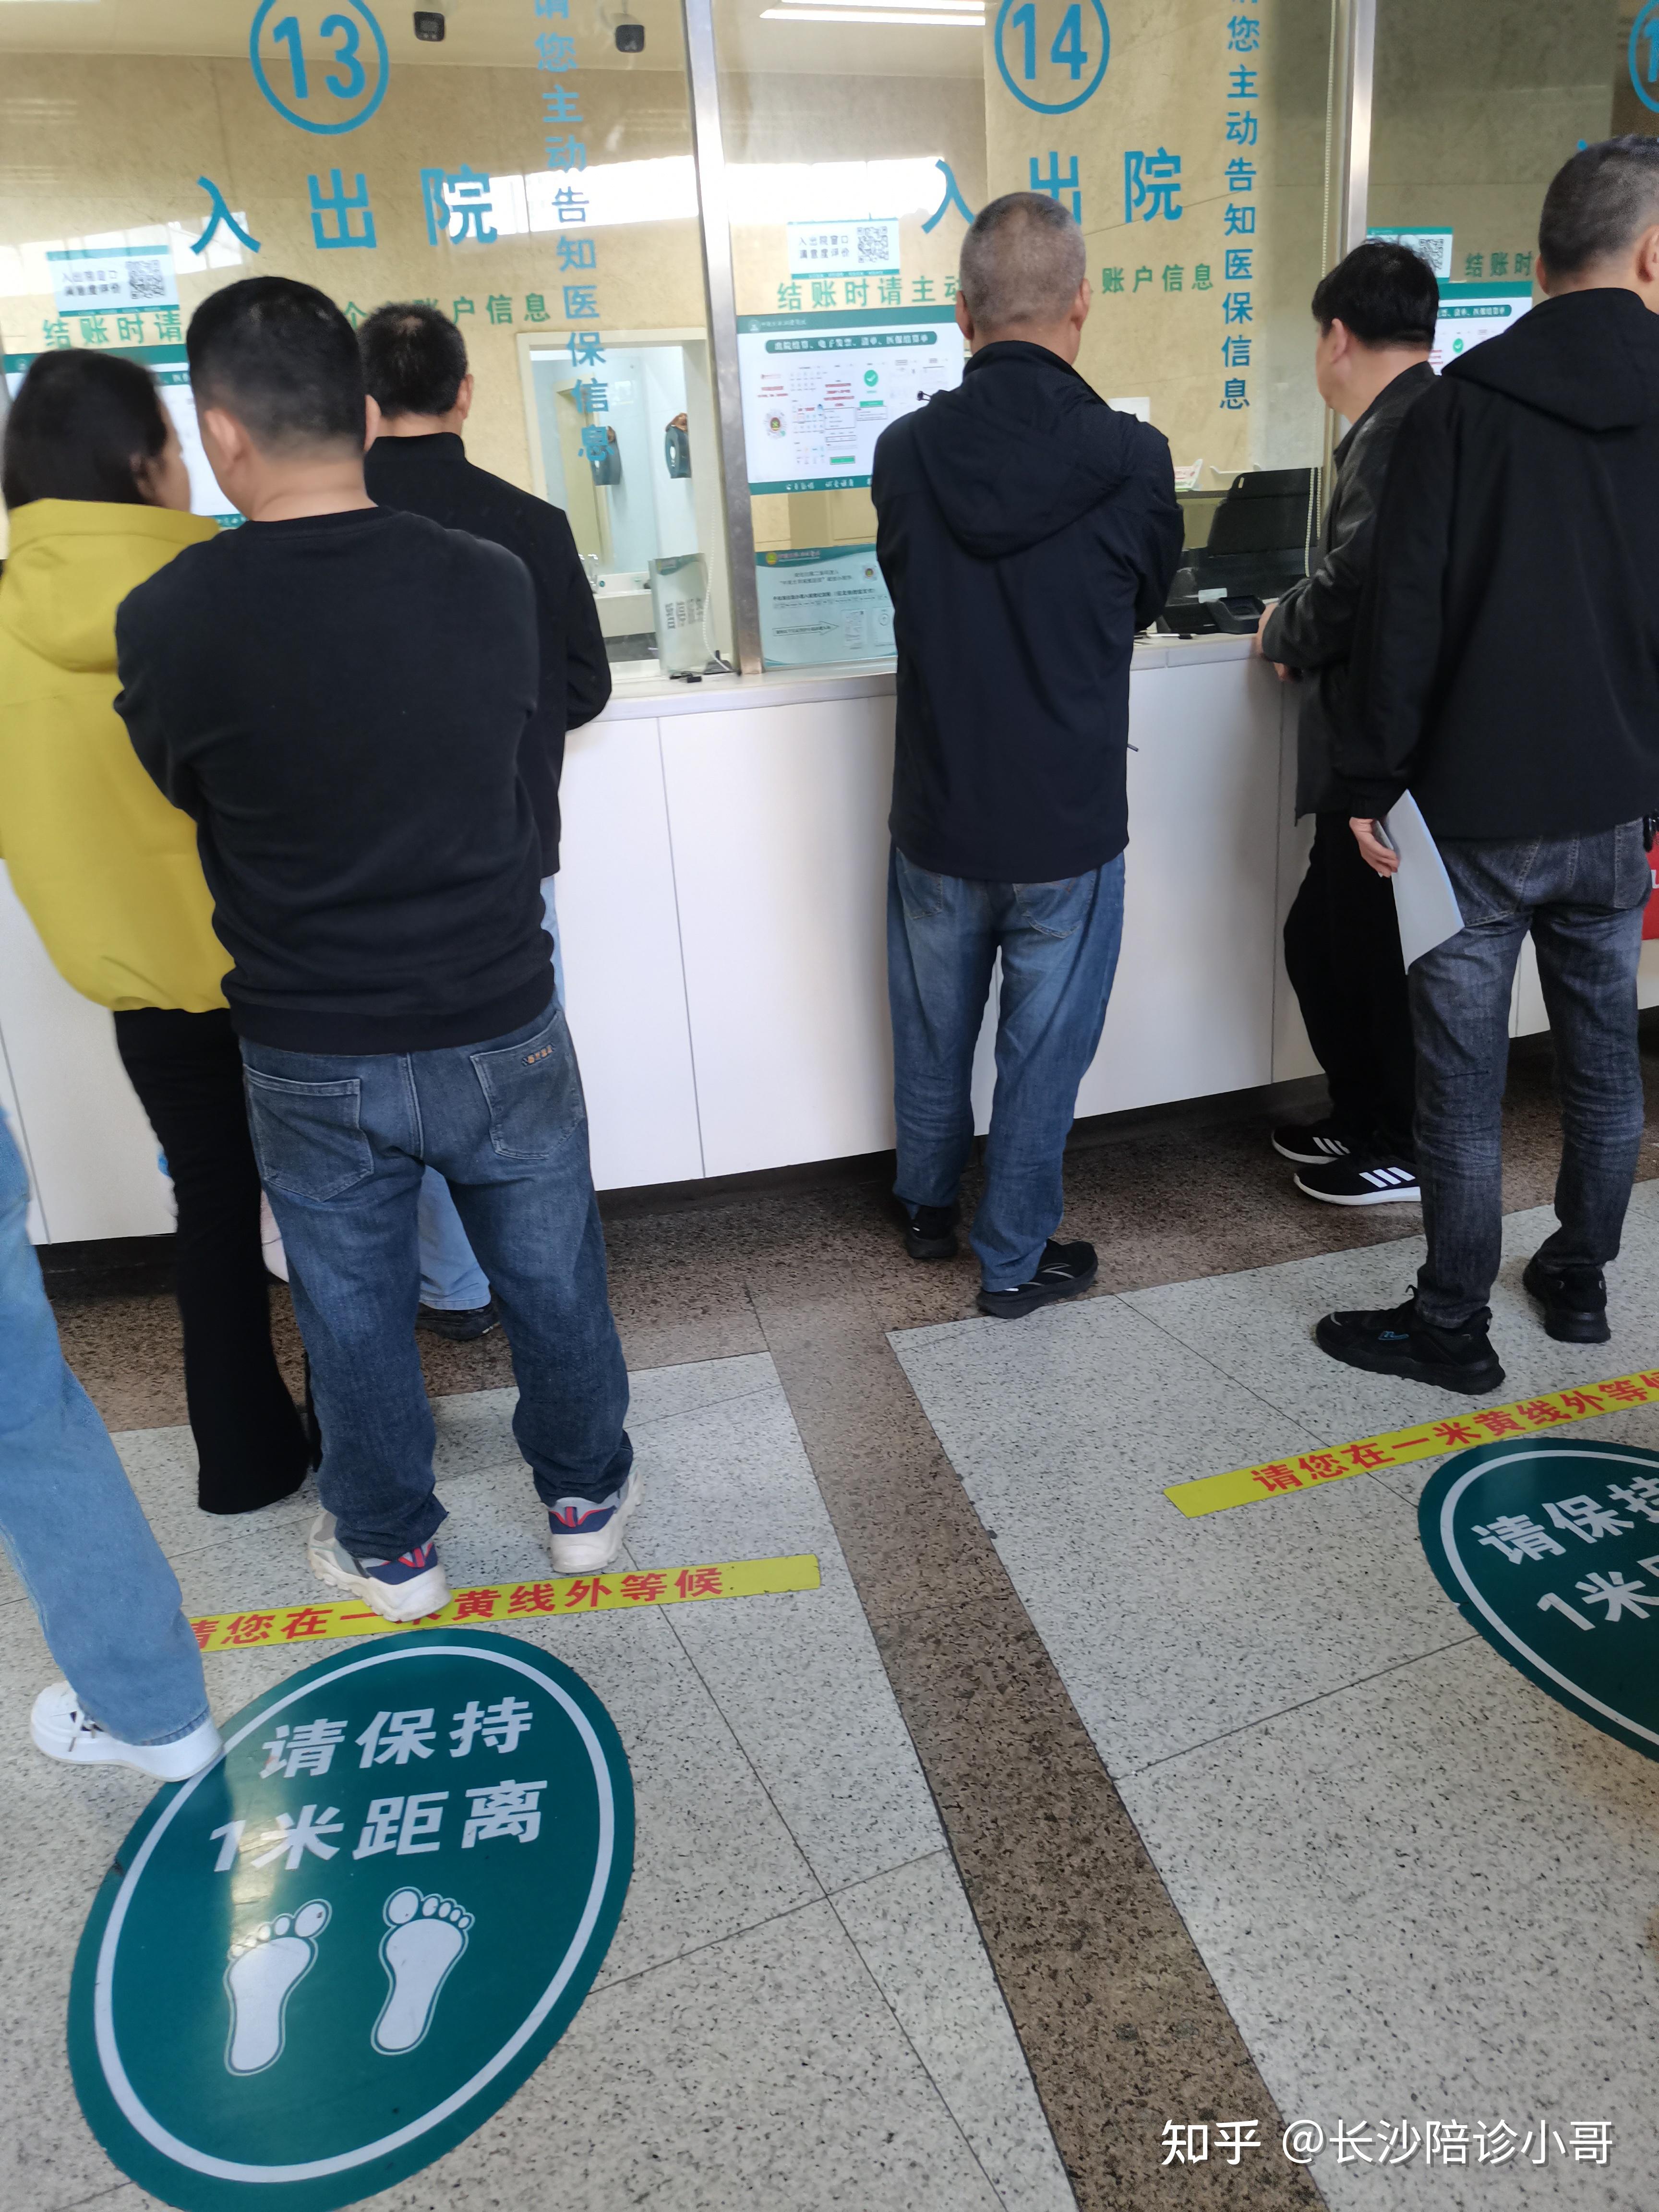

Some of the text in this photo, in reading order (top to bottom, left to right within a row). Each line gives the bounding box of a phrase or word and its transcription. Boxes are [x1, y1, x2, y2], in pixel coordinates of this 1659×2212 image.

[273, 14, 366, 100] 13
[1012, 3, 1088, 80] 14
[190, 163, 498, 255] 入出院
[1220, 0, 1260, 409] 您主动告知医保信息
[190, 1566, 723, 1648] 请您在一黄线外等候
[1537, 1554, 1659, 1631] 1米
[260, 1696, 533, 1779] 请保持
[209, 1779, 548, 1872] 1米距离
